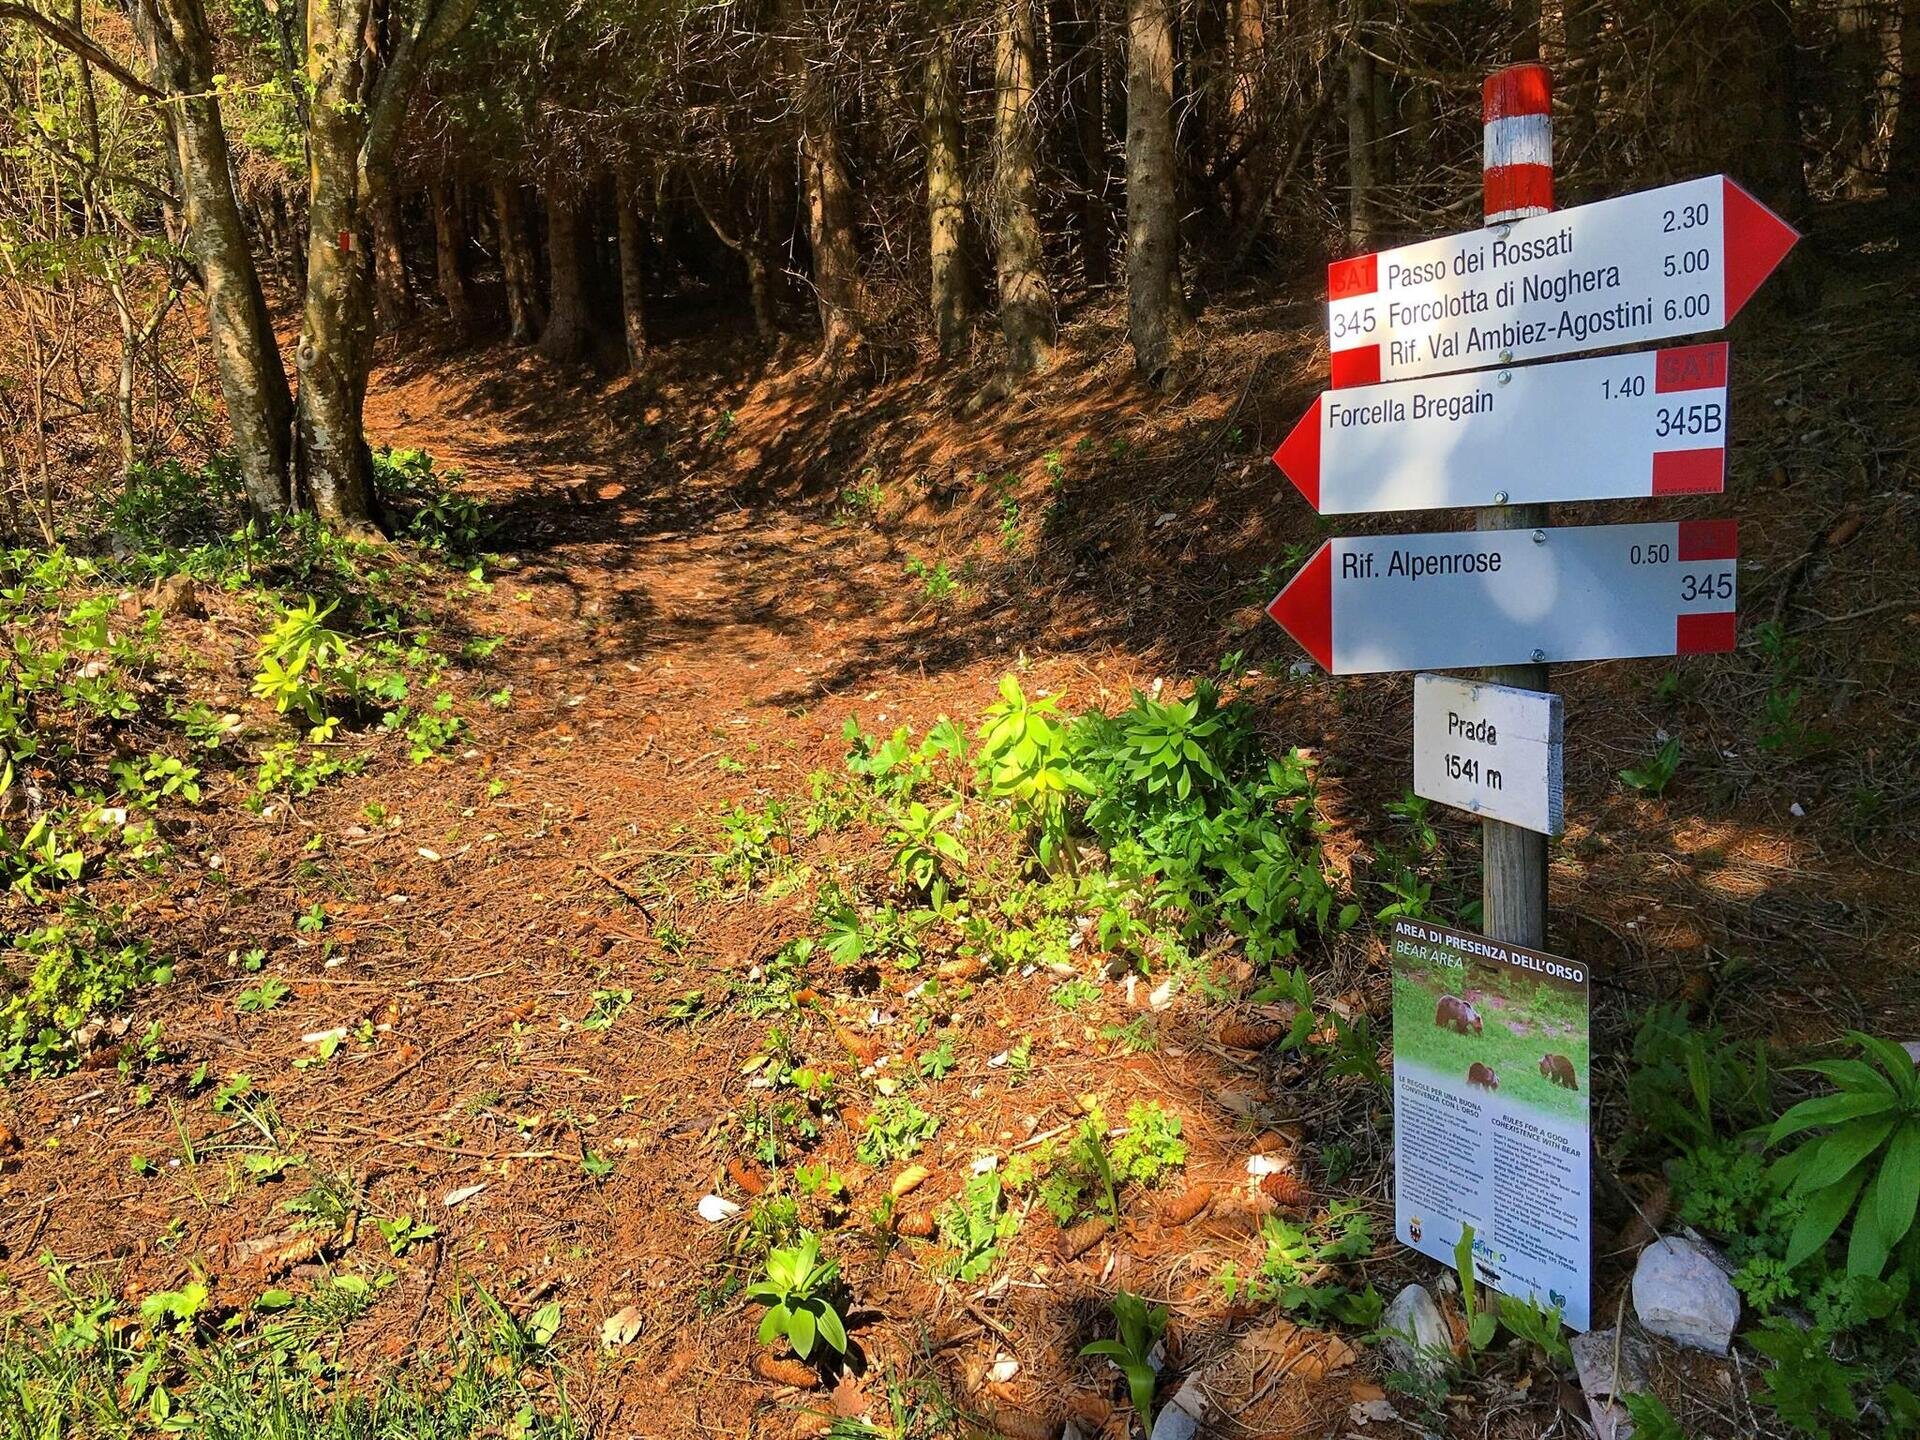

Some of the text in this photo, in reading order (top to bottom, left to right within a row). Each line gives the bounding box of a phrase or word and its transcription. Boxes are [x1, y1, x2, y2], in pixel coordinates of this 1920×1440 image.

[1388, 203, 1709, 290] Passo dei Rossati 2.30
[1389, 249, 1710, 328] Forcolotta di Noghera 5.00
[1334, 307, 1376, 338] 345
[1391, 293, 1710, 367] Rif. Val Ambiez-Agostini 6.00
[1662, 351, 1719, 383] SAT
[1329, 376, 1646, 428] Forcella Bregain 1.40
[1656, 404, 1722, 438] 345B
[1342, 544, 1670, 581] Rif. Alpenrose 0.50
[1681, 573, 1733, 602] 345
[1448, 711, 1497, 746] Prada
[1445, 754, 1502, 790] 1541 m
[1395, 922, 1584, 983] AREA DI PRESENZA DELL'ORSO
[1397, 940, 1464, 970] BEAR AREA
[1401, 1082, 1440, 1103] CONVIVENZA
[1441, 1098, 1454, 1109] CON
[1431, 1086, 1442, 1097] PER
[1443, 1092, 1457, 1102] UNA
[1491, 1117, 1580, 1157] COHEXISTENCE WITH BEAR
[1502, 1115, 1567, 1145] RULES FOR A GOOD
